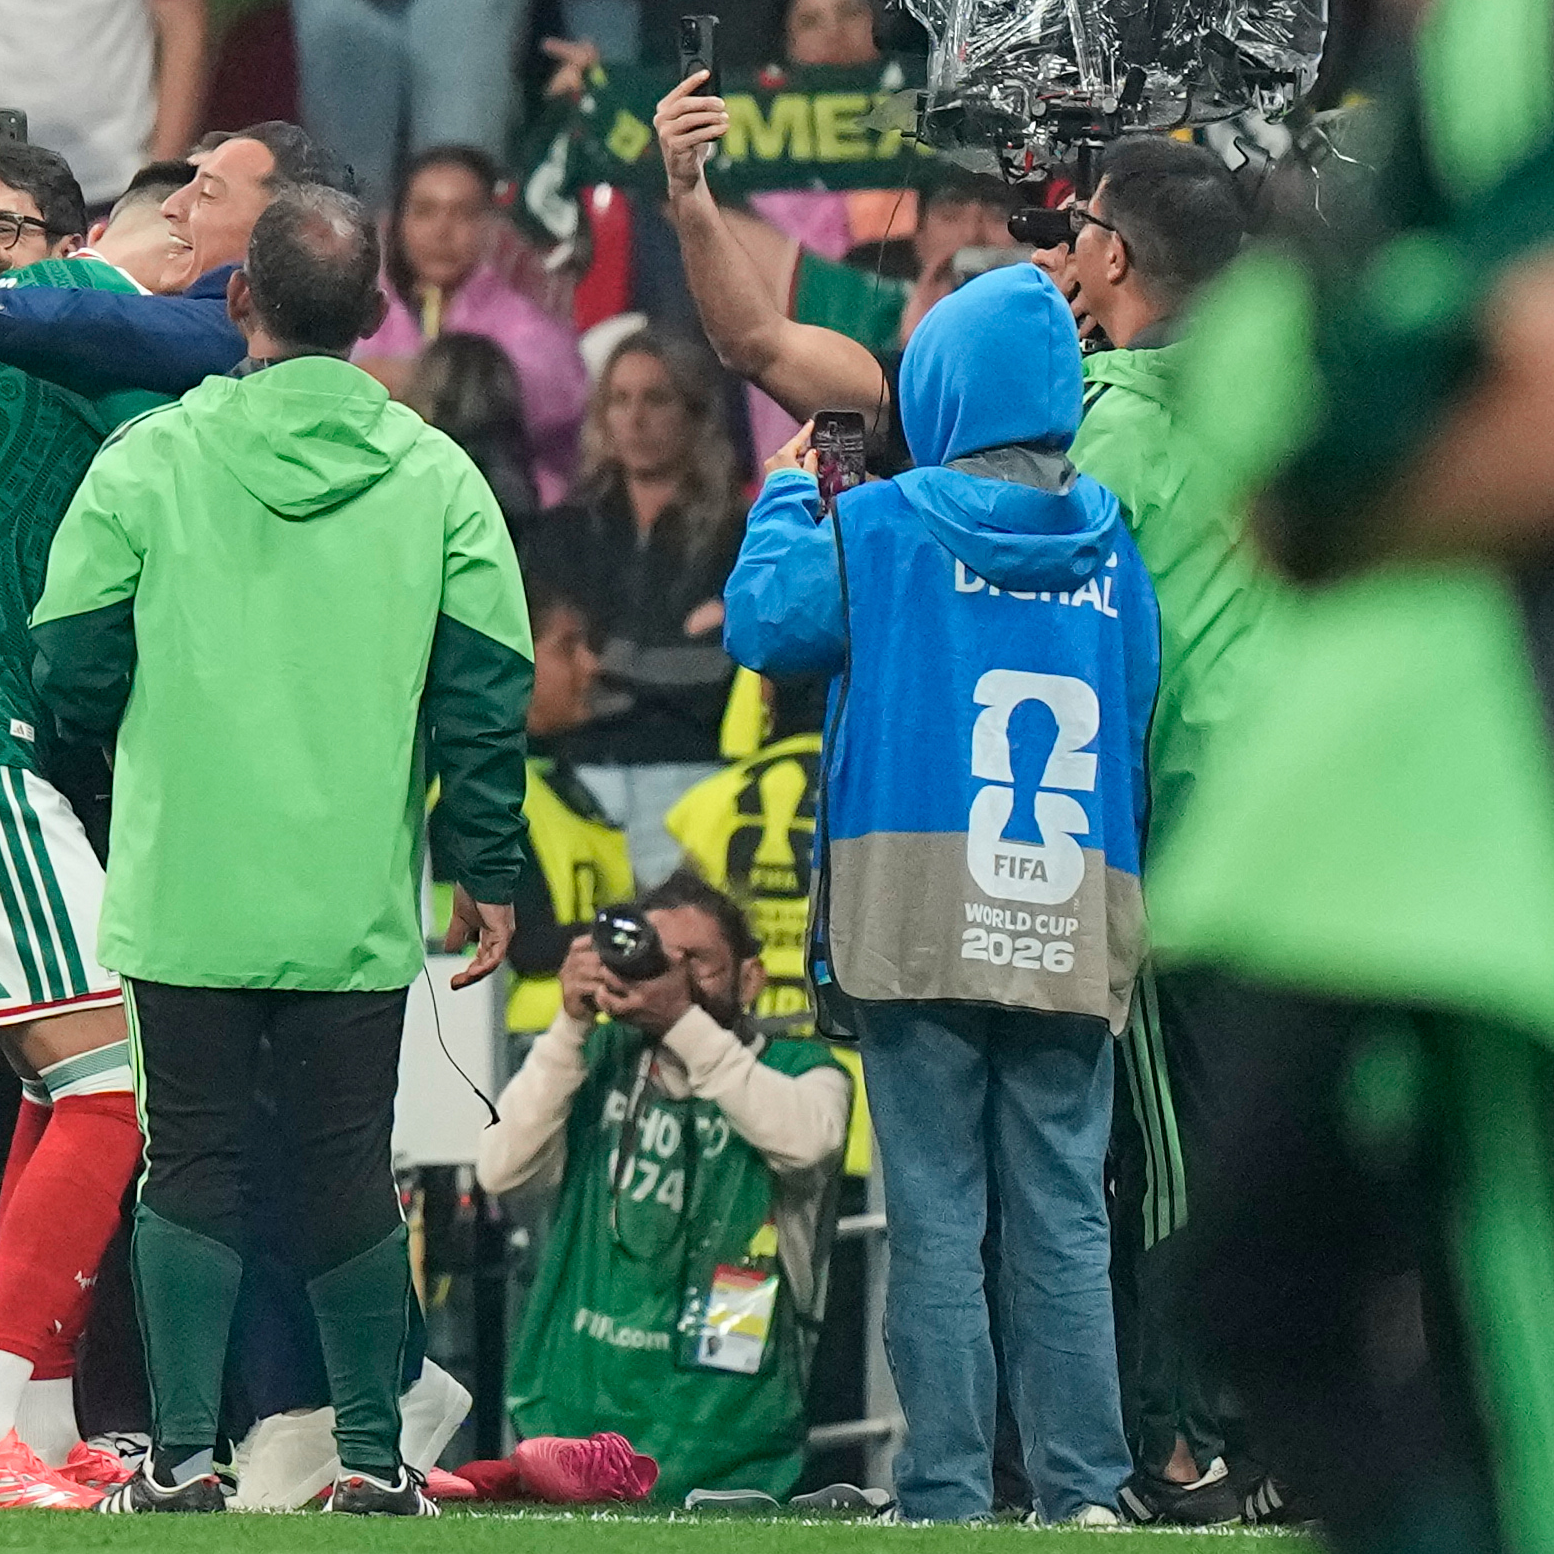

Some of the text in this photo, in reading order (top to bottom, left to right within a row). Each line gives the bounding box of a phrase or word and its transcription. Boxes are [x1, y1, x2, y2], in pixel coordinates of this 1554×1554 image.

[994, 854, 1048, 883] FIFA
[964, 903, 1079, 936] WORLD CUP
[961, 927, 1075, 973] 2026
